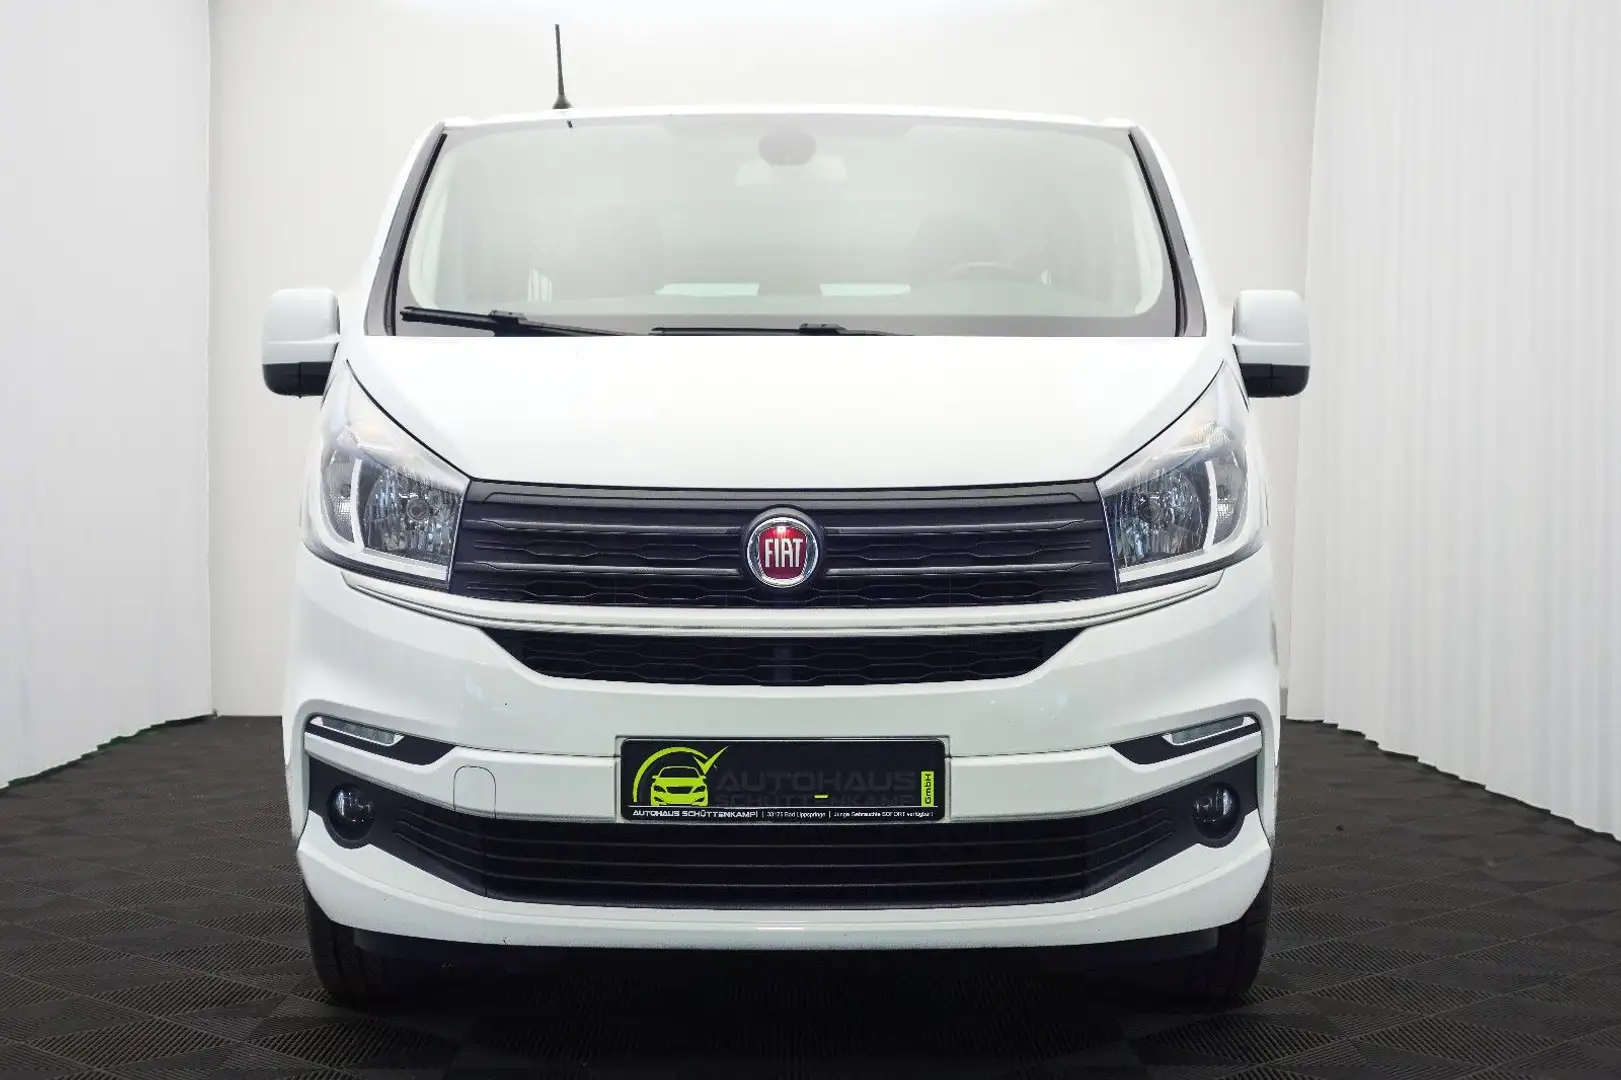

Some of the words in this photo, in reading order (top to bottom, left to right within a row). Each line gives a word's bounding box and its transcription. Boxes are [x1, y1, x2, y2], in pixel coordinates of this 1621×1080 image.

[765, 538, 803, 568] FIAT
[716, 770, 917, 792] AUTOHAUS
[924, 773, 932, 805] GmbH
[632, 809, 680, 817] AUTOHAUS
